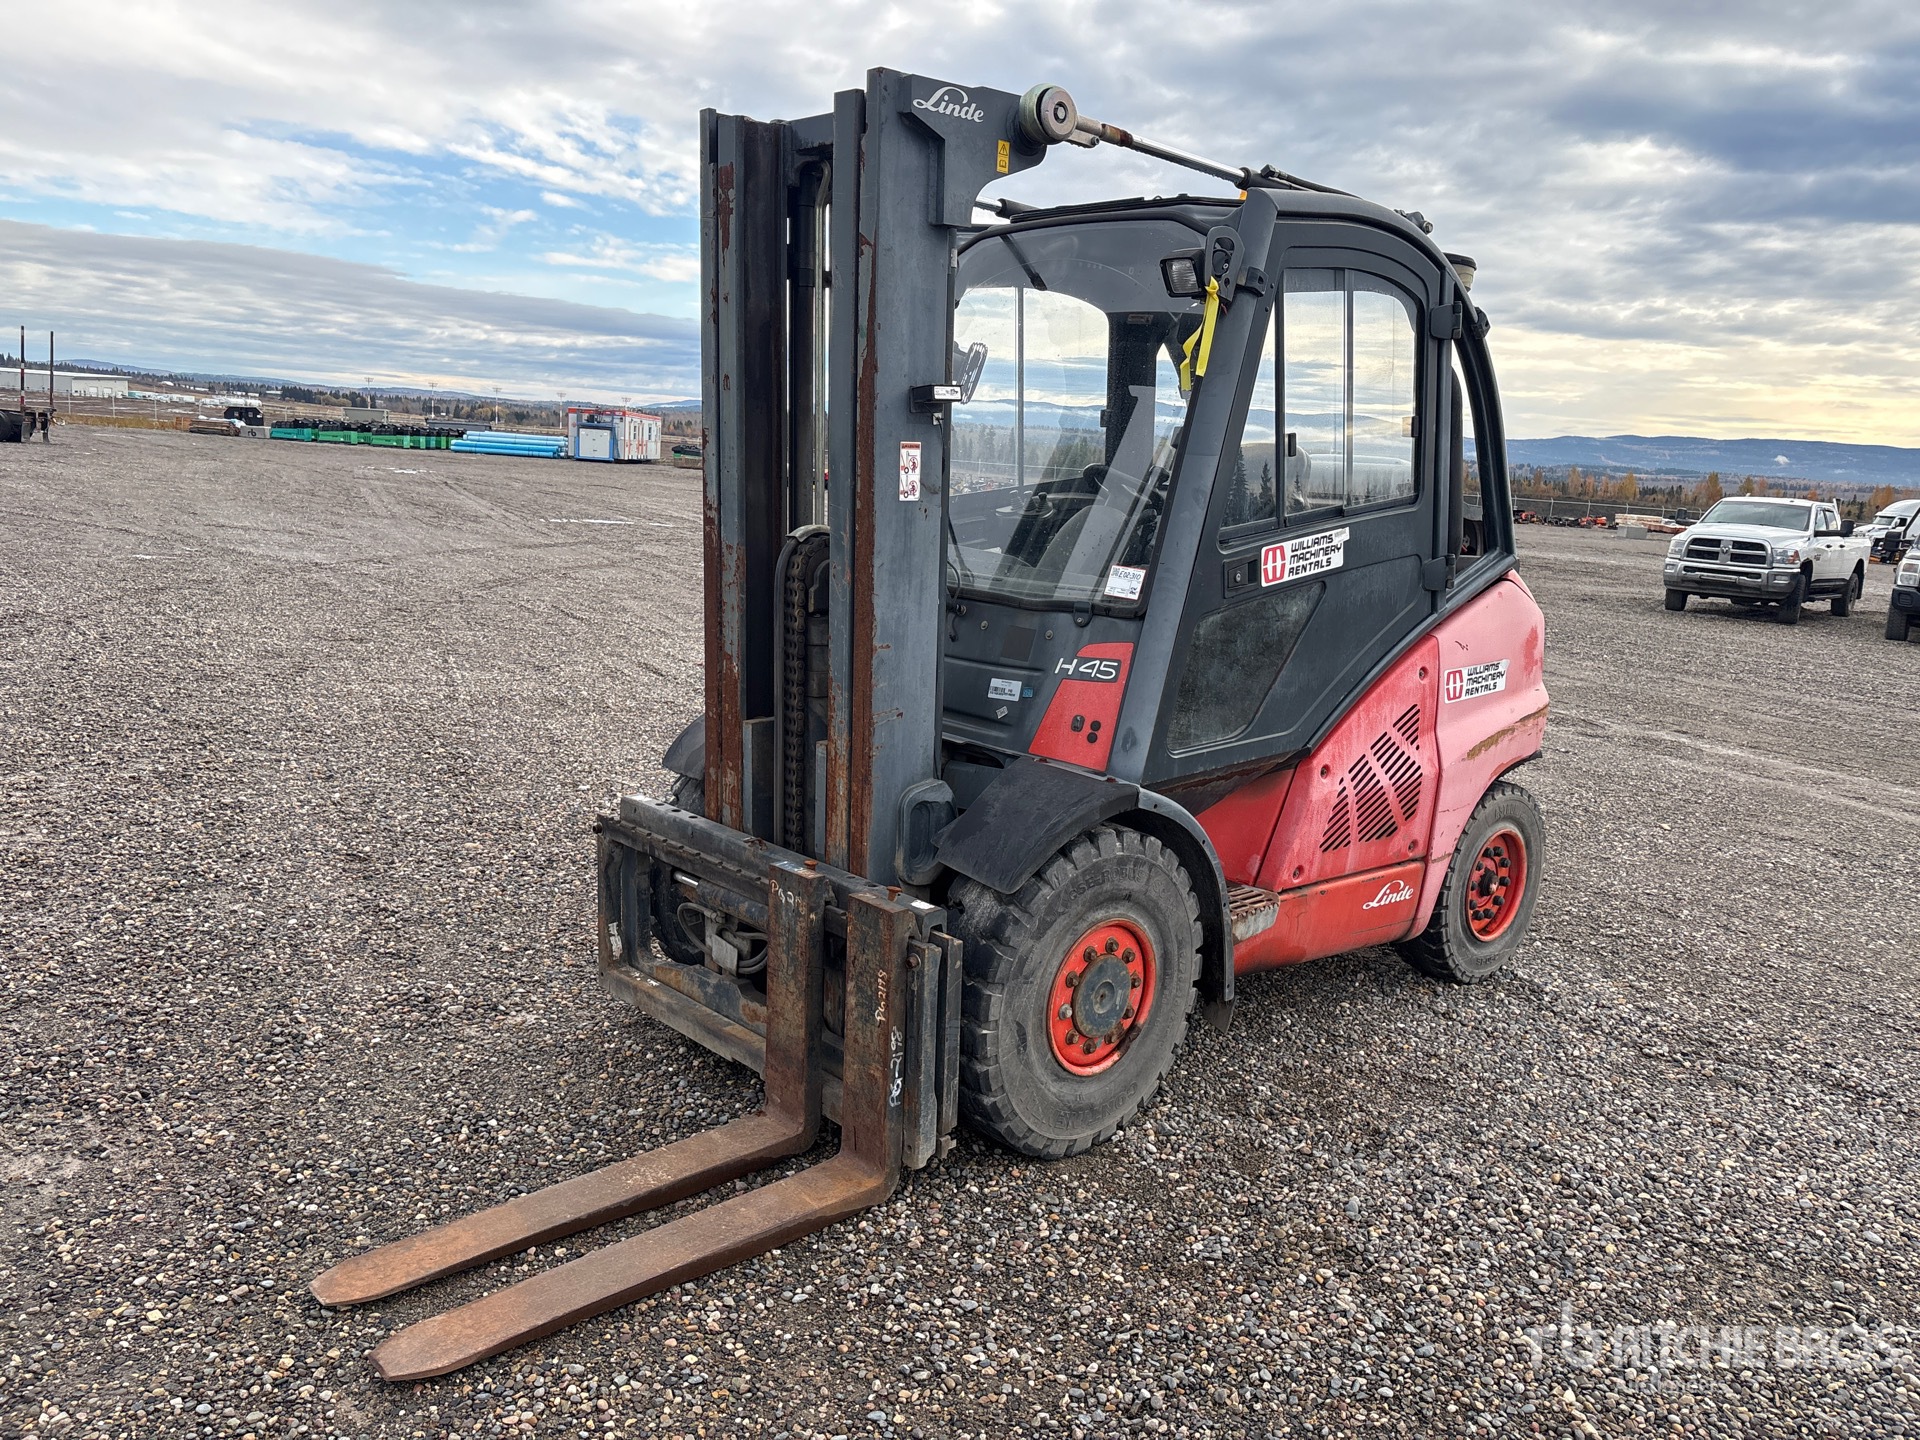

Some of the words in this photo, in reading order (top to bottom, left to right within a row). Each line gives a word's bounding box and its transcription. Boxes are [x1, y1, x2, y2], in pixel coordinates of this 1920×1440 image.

[913, 86, 984, 123] Linde
[1291, 534, 1333, 552] WILLIAMS
[1289, 543, 1342, 565] MACHINERY
[1288, 557, 1331, 577] RENTALS
[1466, 670, 1505, 687] MACHINERY
[1468, 662, 1500, 676] WILLIAMS
[1465, 682, 1497, 697] RENTALS
[1362, 880, 1414, 910] Linde
